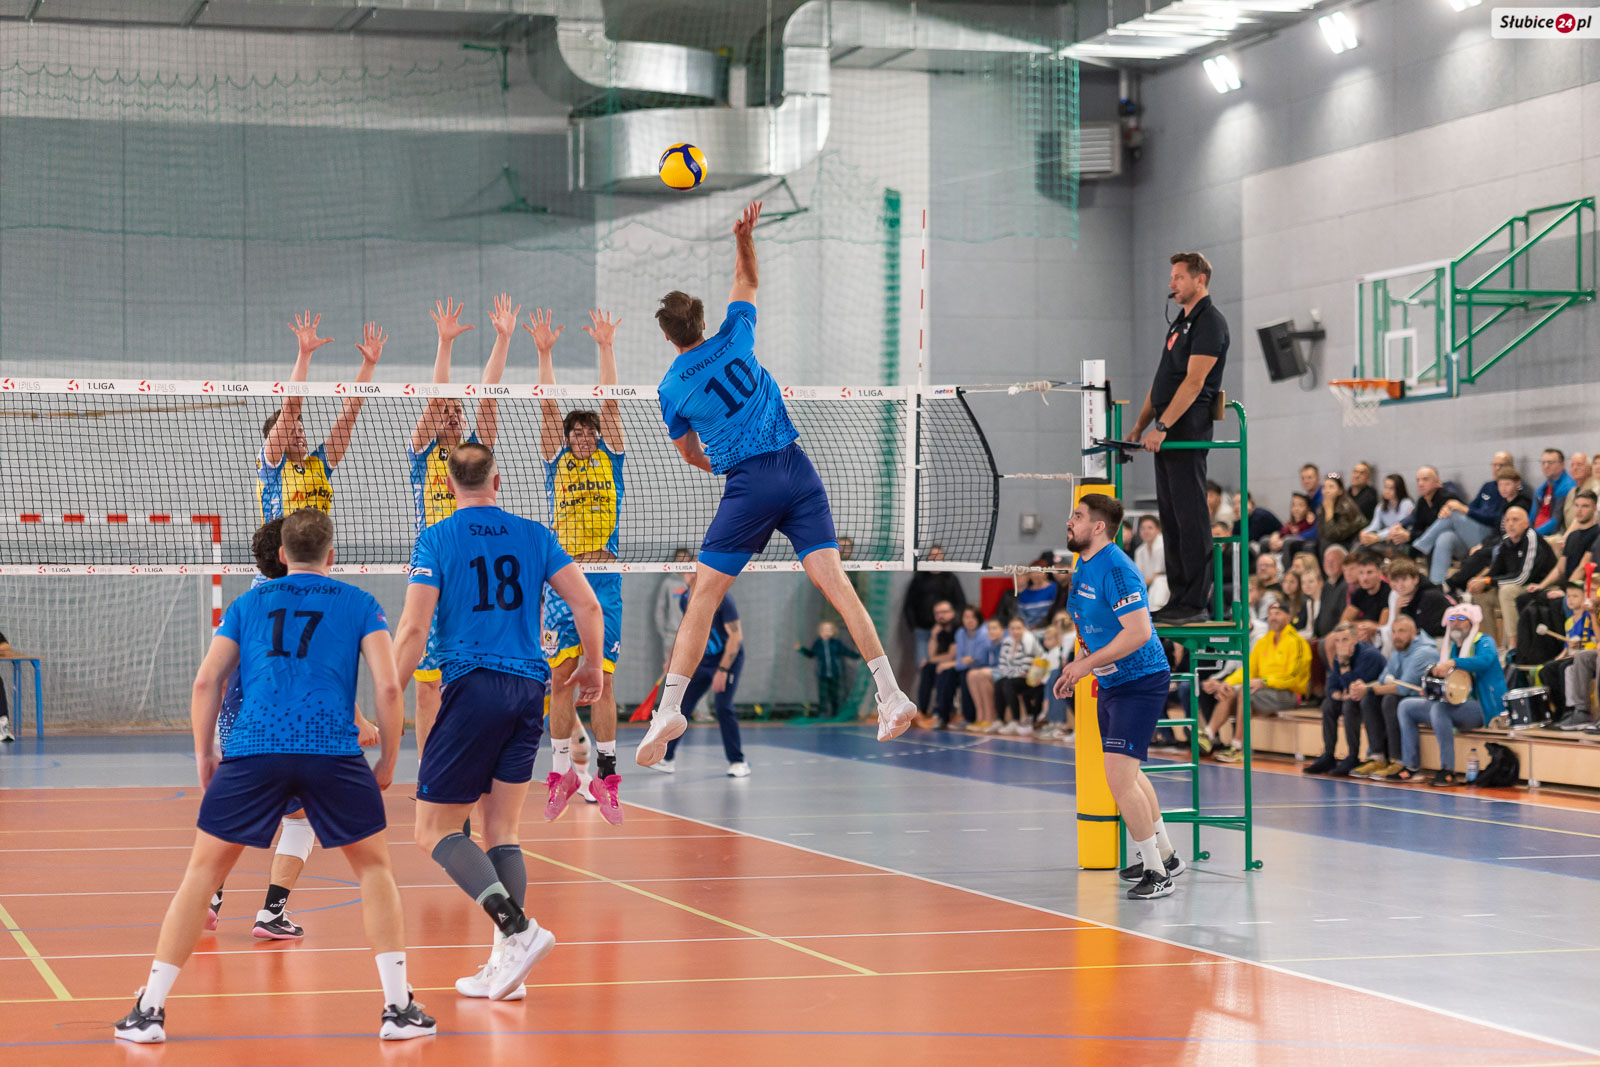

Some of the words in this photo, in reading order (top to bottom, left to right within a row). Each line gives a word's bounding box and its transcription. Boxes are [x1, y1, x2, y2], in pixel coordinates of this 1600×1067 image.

[704, 357, 757, 419] 10
[469, 525, 509, 537] SZALA
[469, 554, 524, 613] 18
[266, 607, 325, 659] 17
